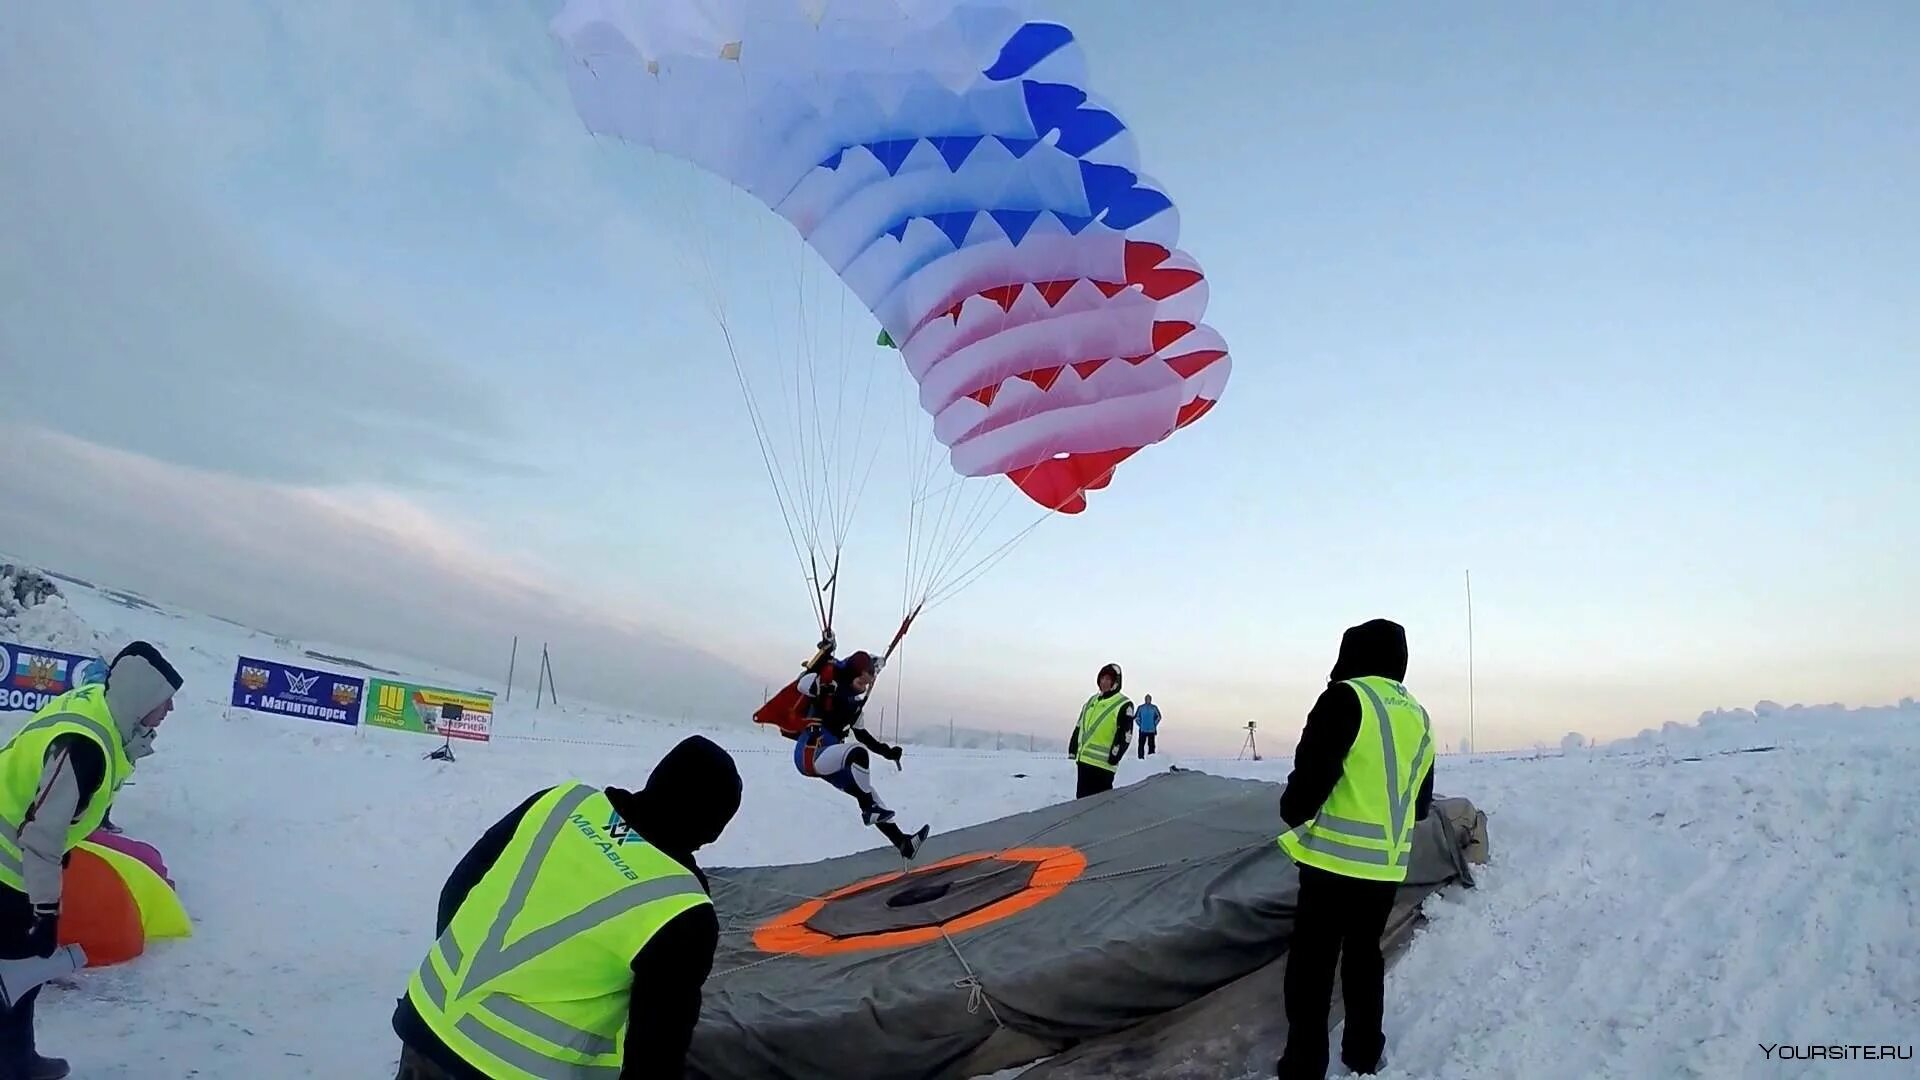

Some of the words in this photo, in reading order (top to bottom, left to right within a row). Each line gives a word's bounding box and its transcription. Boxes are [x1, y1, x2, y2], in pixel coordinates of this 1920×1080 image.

[0, 688, 59, 711] ВОСИ
[261, 695, 347, 720] Магнитогорск
[568, 814, 638, 881] МагАвиа
